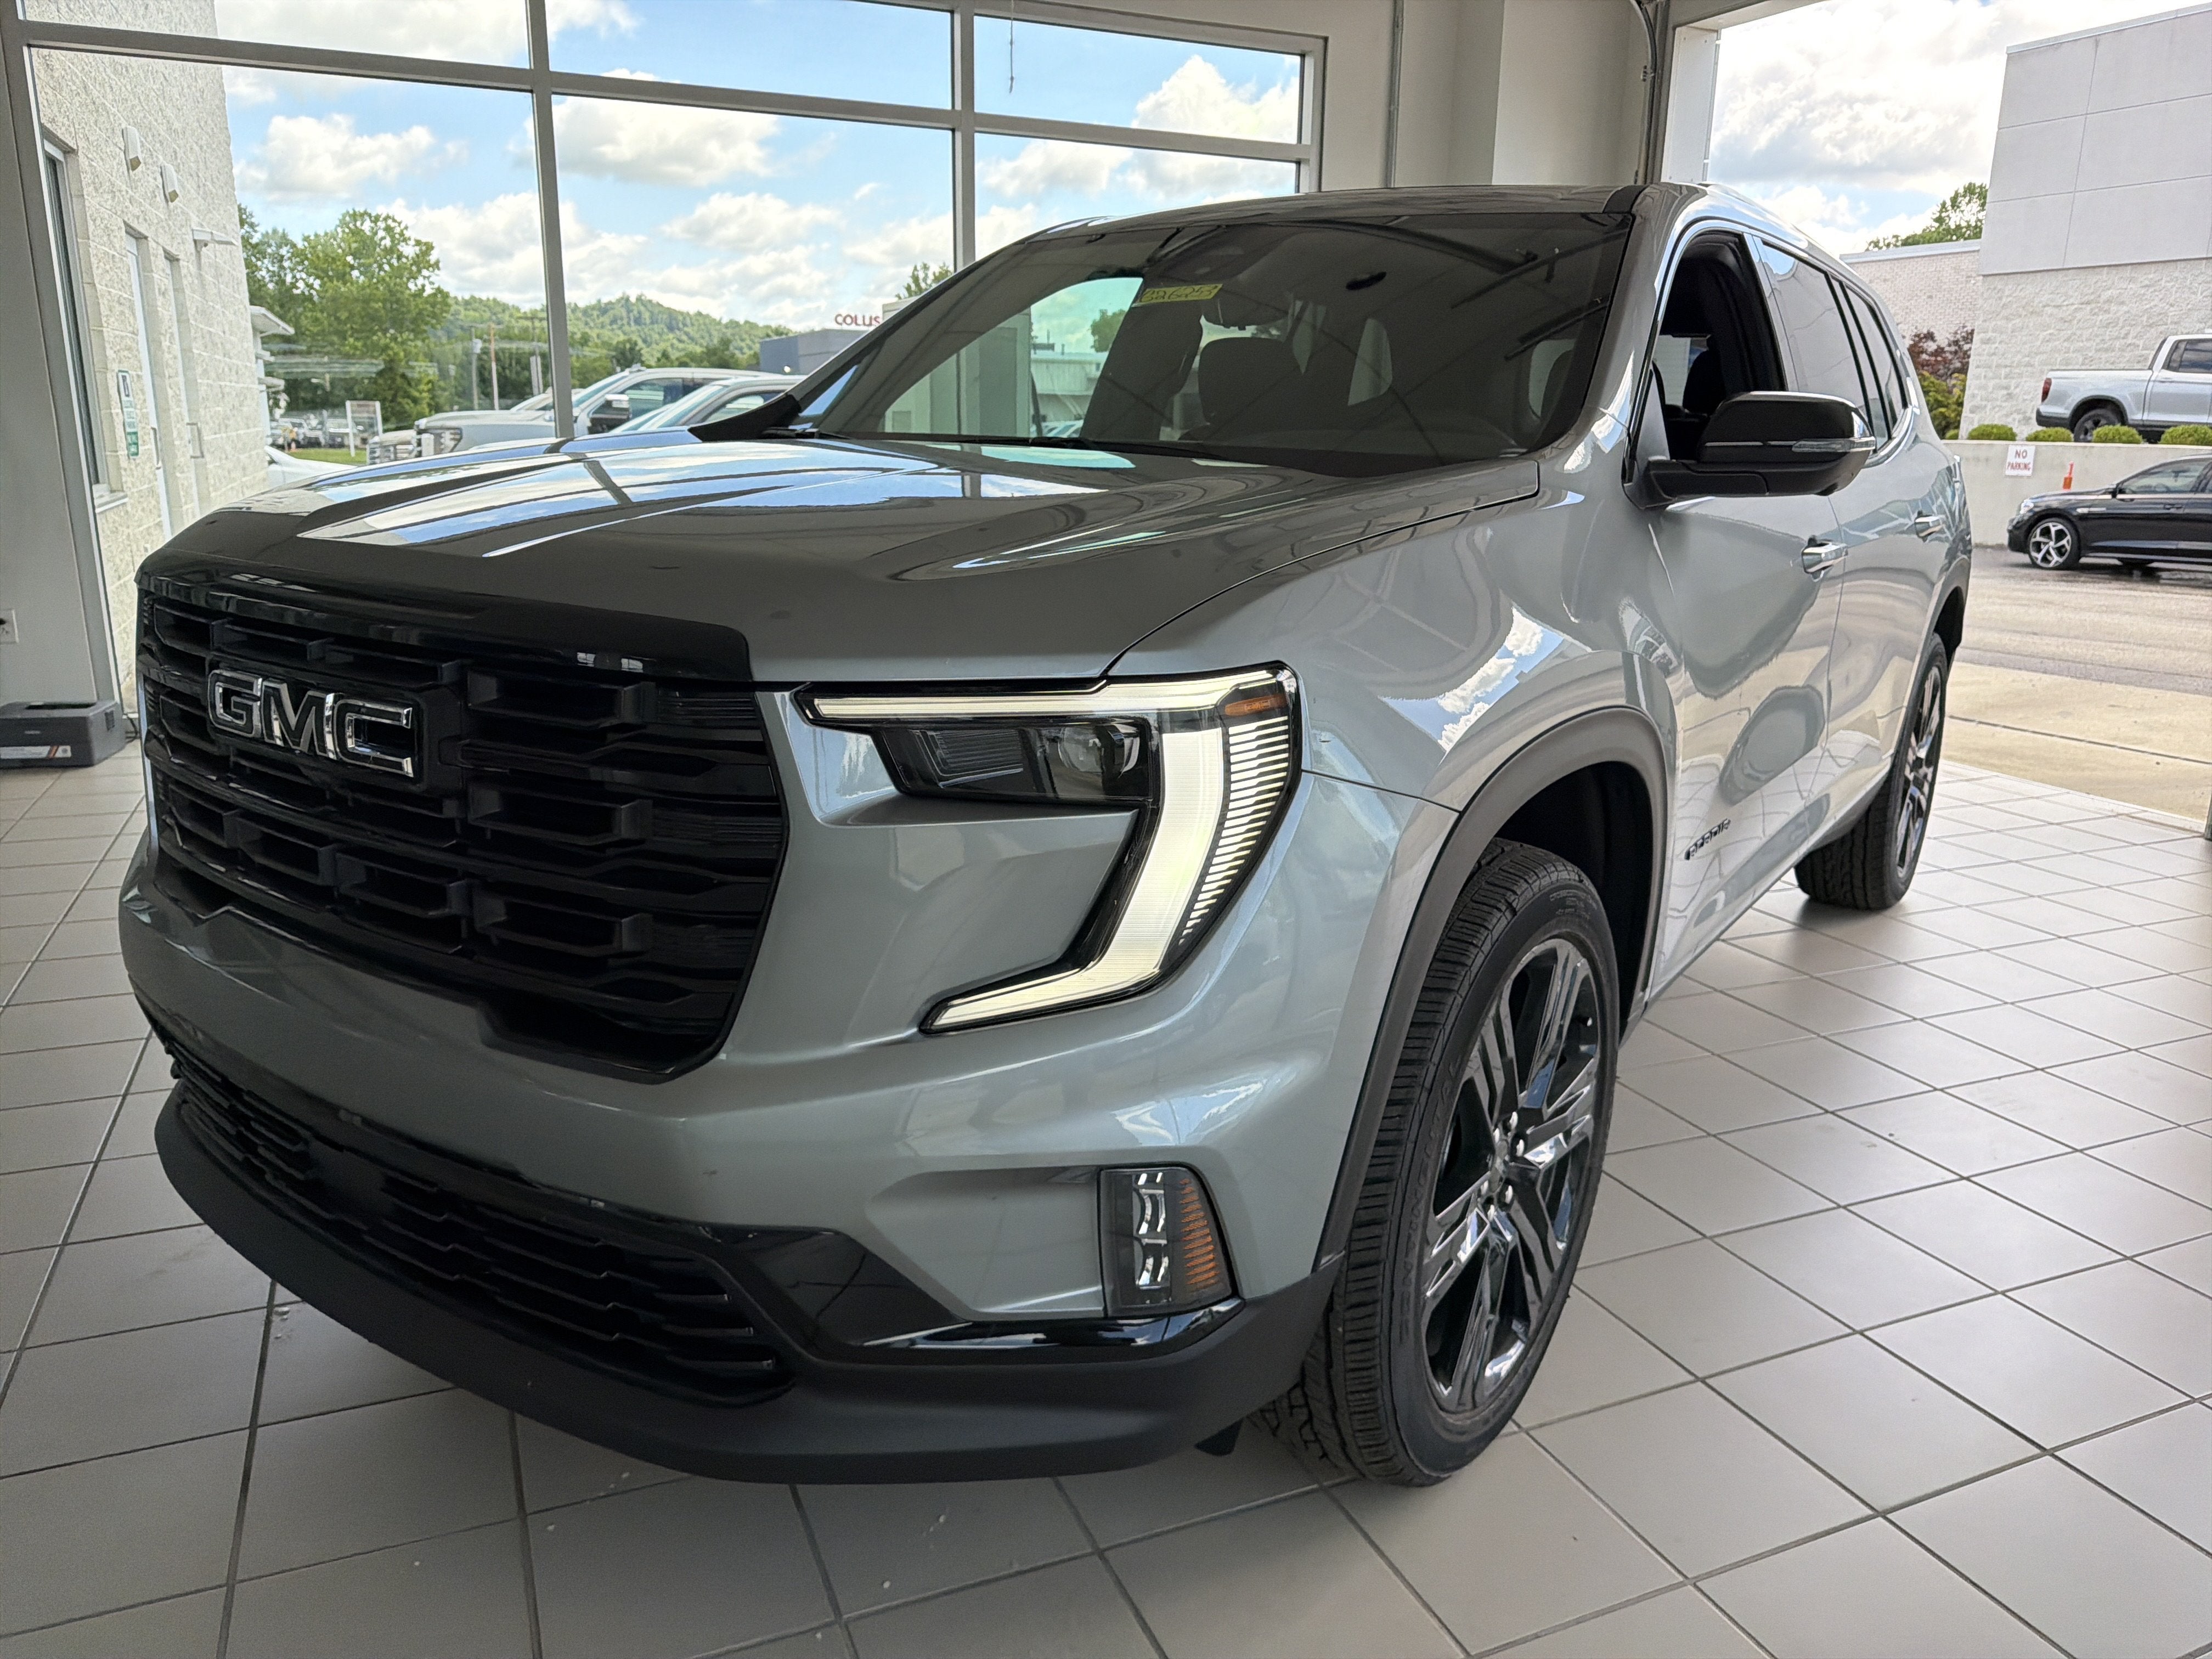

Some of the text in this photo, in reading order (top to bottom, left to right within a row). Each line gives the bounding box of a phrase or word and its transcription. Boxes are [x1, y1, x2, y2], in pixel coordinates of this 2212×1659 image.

[2015, 449, 2028, 459] NO
[2007, 462, 2032, 471] PARKING
[208, 669, 414, 777] GMC
